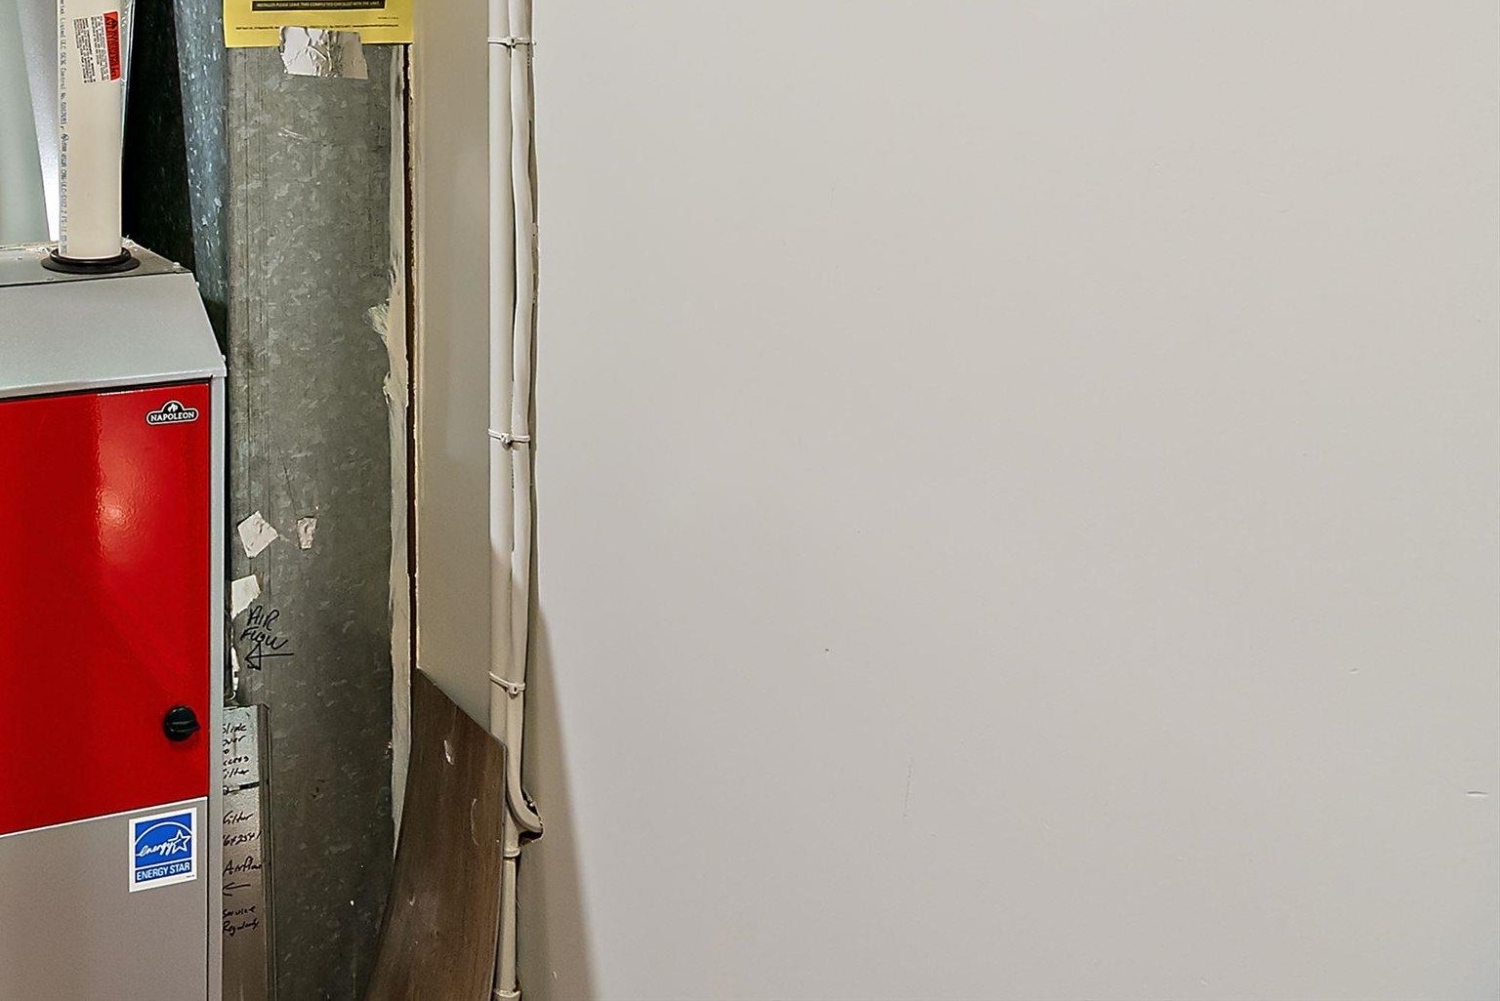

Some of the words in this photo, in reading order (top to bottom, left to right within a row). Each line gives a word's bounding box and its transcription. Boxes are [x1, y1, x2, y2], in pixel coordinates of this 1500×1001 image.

[150, 411, 195, 422] NAPOLEON
[247, 605, 280, 631] AIR
[137, 866, 168, 880] ENERGY
[170, 862, 190, 874] STAR
